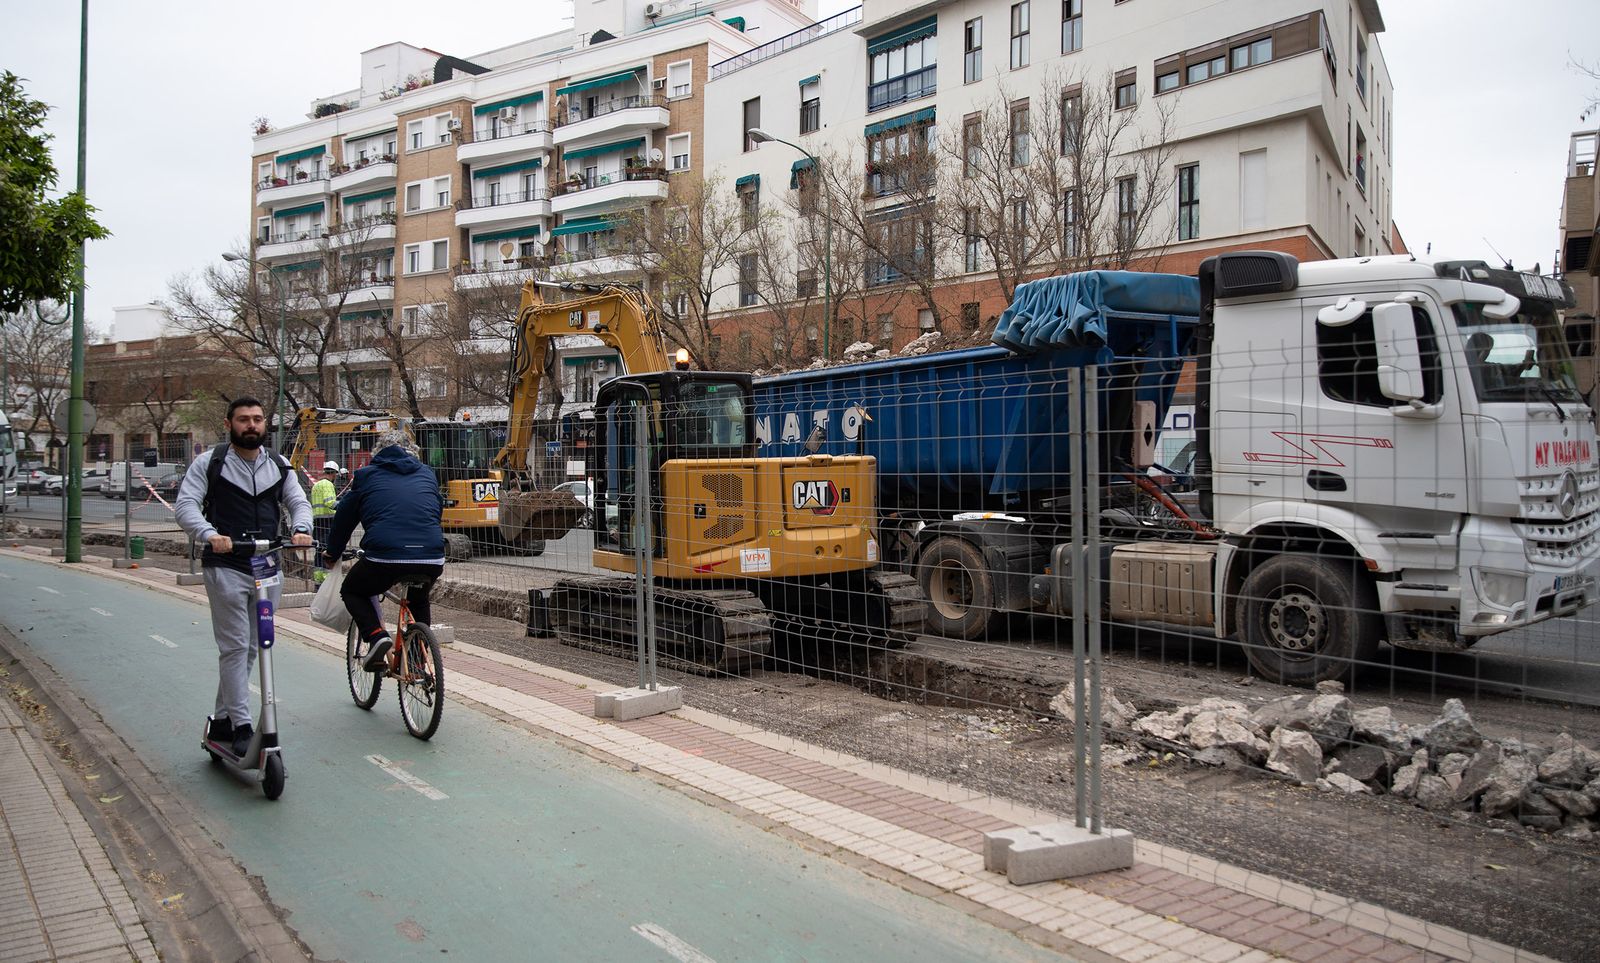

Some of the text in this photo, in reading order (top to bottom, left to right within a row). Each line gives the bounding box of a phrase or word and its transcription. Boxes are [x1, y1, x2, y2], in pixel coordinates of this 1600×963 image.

[569, 310, 582, 327] CAT
[1535, 441, 1549, 466] MY
[475, 483, 500, 502] CAT
[793, 481, 828, 509] CAT
[745, 553, 766, 562] VFM
